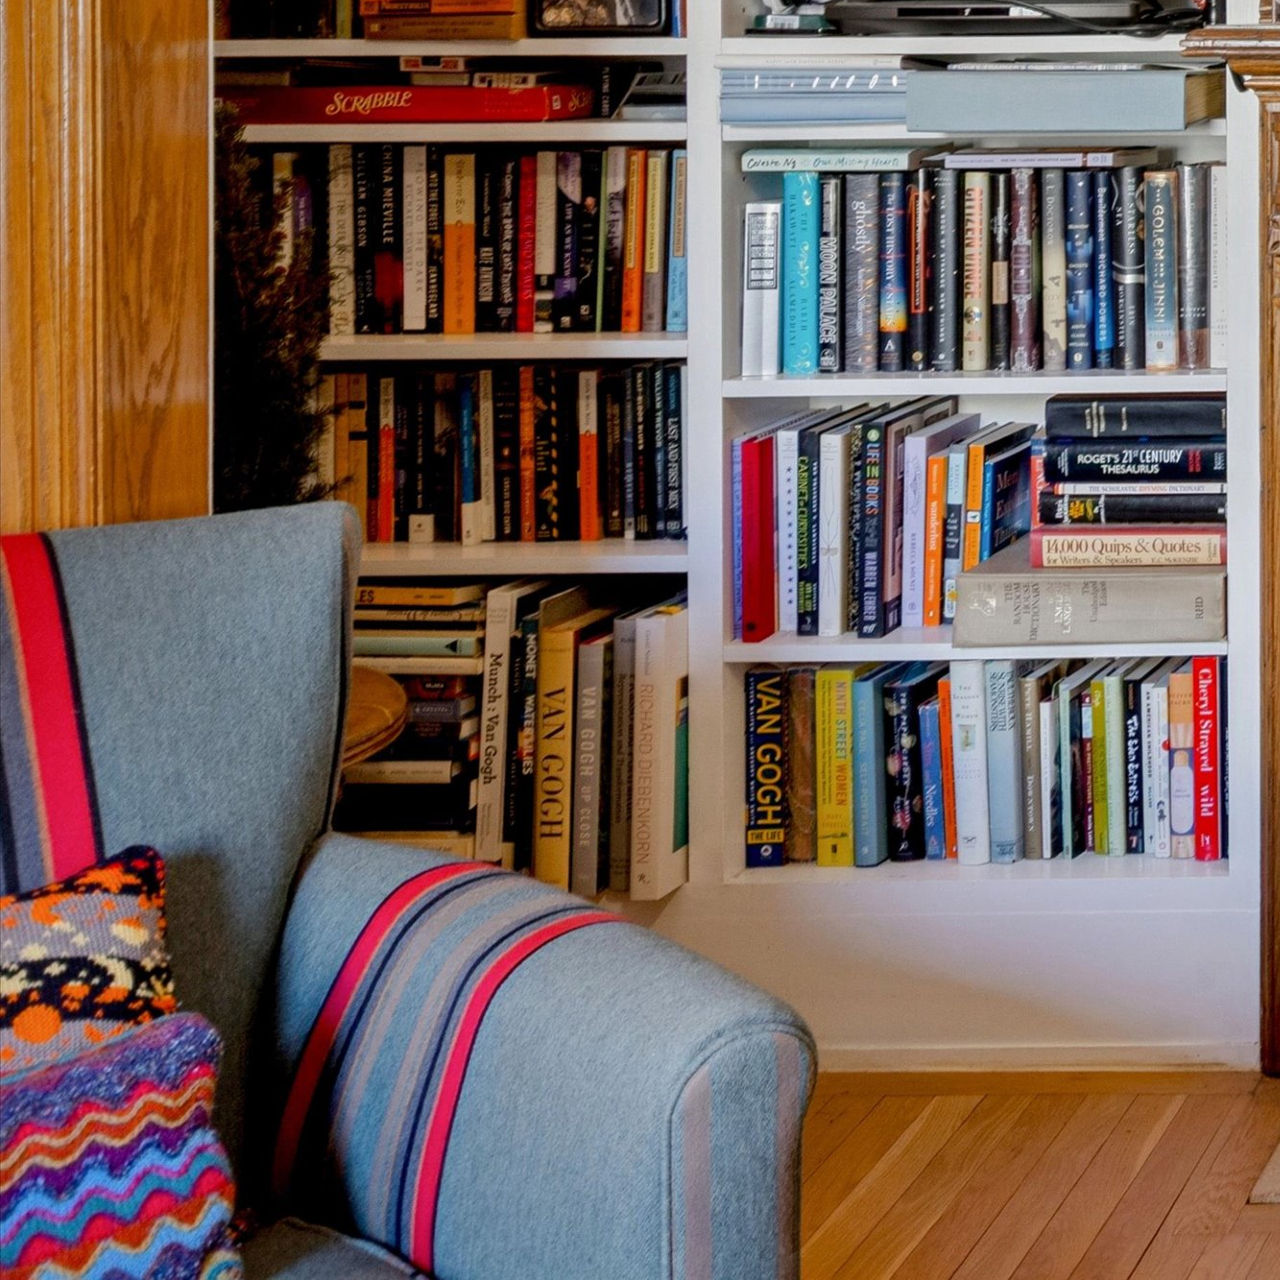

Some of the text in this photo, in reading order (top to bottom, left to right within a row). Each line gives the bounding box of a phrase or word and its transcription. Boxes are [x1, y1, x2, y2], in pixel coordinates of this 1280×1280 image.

[325, 91, 413, 115] SCRABBLE
[357, 152, 367, 247] WILLIAM GIBSON
[852, 200, 871, 254] ghostly
[819, 237, 838, 344] MOON PALACE
[654, 370, 664, 448] WILLIAM TREVOR
[866, 442, 880, 464] LIFE
[1077, 453, 1120, 464] ROGET'S
[1139, 449, 1183, 463] CENTURY
[1101, 465, 1160, 474] THESAURUS
[797, 456, 809, 570] CABINET CURIOSITIES
[865, 479, 880, 515] BOOKS
[928, 500, 938, 551] wanderlust
[1045, 538, 1202, 555] 14,000 Quips & Quotes
[862, 551, 878, 628] WARREN LEHRER
[1023, 583, 1031, 614] HOUSE
[1030, 583, 1039, 641] DICTIONARY
[1195, 596, 1204, 620] RHD
[488, 652, 503, 703] Munch
[485, 713, 500, 743] Van
[581, 686, 596, 721] VAN
[480, 745, 498, 786] Gogh
[540, 686, 566, 839] VAN GOGH
[580, 727, 595, 784] GOGH
[756, 676, 782, 825] VAN GOGH
[835, 681, 848, 806] NINTH STREET WOMEN
[1198, 668, 1214, 818] Cheryl Strayed wild
[636, 683, 654, 865] RICHARD DIEBENKORN
[579, 808, 591, 848] CLOSE
[925, 784, 937, 827] Needles
[750, 829, 782, 841] THE LIFE
